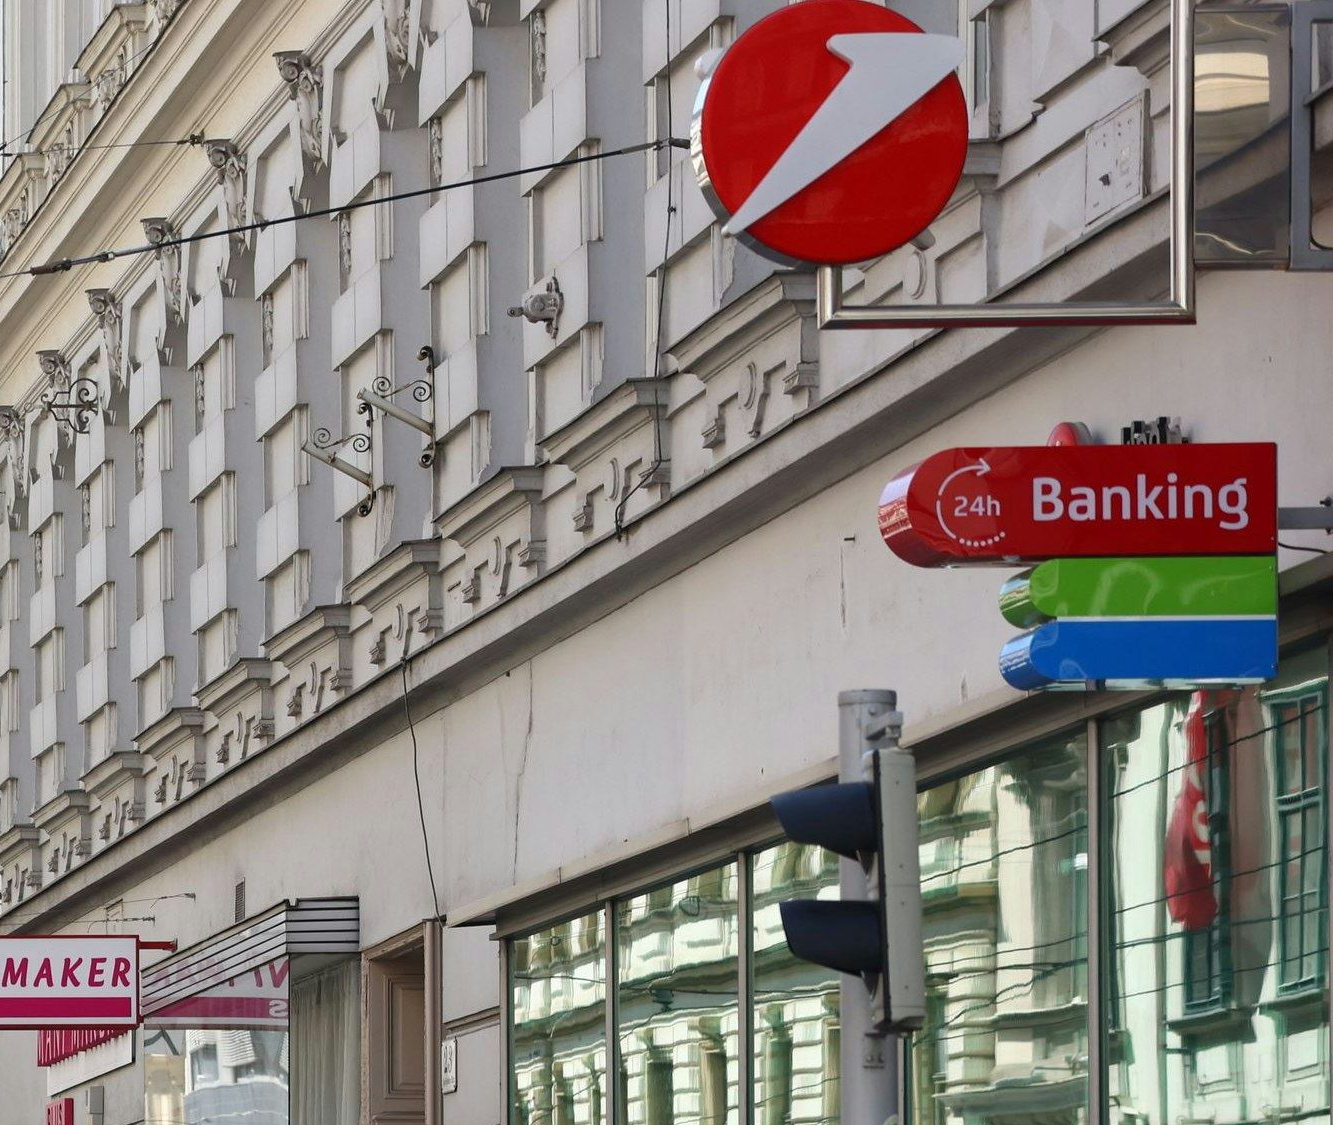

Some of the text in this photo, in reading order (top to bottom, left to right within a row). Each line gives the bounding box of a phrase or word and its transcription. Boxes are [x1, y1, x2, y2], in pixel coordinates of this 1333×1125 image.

[954, 473, 1249, 530] 24h Banking
[1, 957, 131, 987] MAKER
